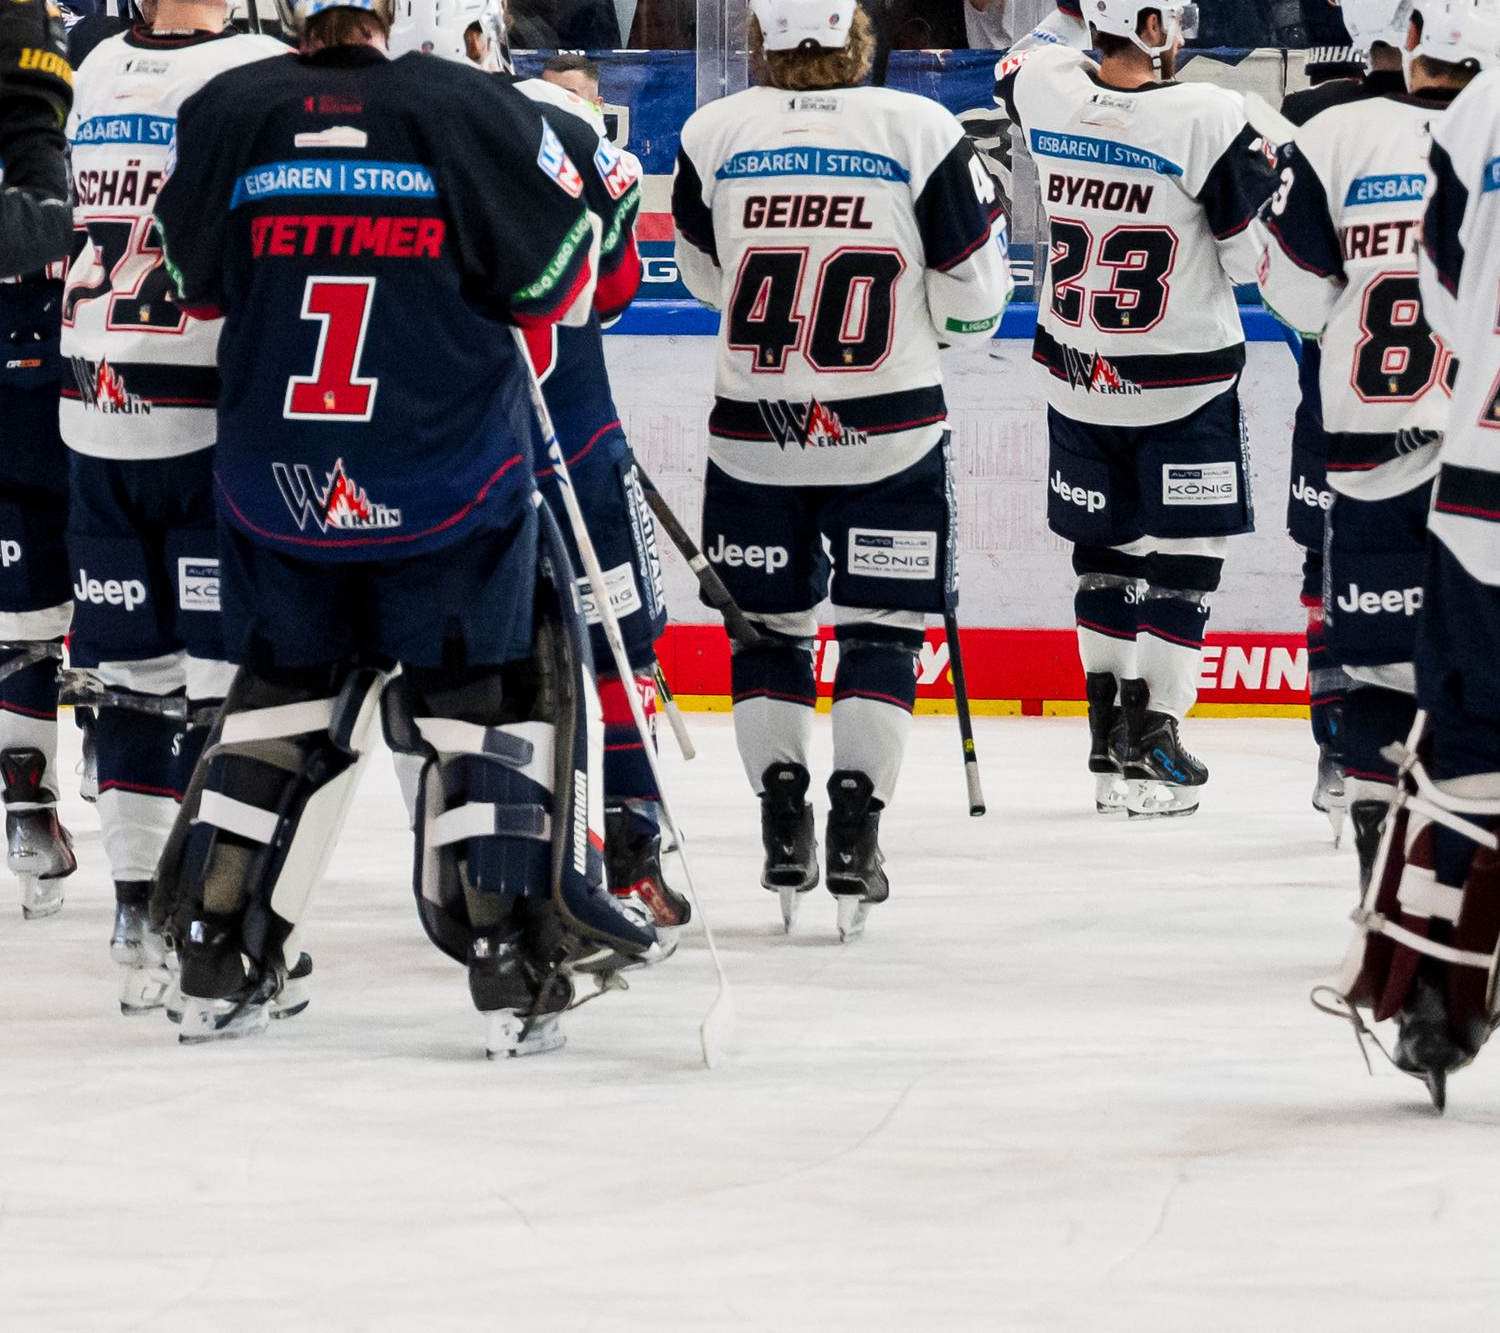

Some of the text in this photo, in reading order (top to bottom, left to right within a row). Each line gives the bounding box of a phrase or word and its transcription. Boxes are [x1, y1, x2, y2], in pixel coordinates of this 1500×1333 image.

[826, 155, 893, 179] STROM
[1037, 135, 1101, 160] EISBÄREN
[353, 168, 436, 194] STROM
[1047, 173, 1155, 215] BYRON
[1356, 181, 1426, 206] EISBÄR
[742, 193, 874, 232] GEIBEL
[251, 215, 447, 260] TETTMER
[1049, 216, 1180, 334] 23
[727, 245, 907, 374] 40
[283, 275, 379, 423] 1
[1049, 469, 1106, 513] Jeep
[1166, 480, 1233, 496] KÖNIG
[1291, 475, 1334, 512] Jee
[707, 534, 790, 575] Jeep
[852, 549, 932, 568] KÖNIG
[73, 569, 146, 613] Jeep
[1337, 582, 1423, 617] Jeep
[1196, 644, 1308, 690] ENN
[572, 770, 589, 876] WARRIOR
